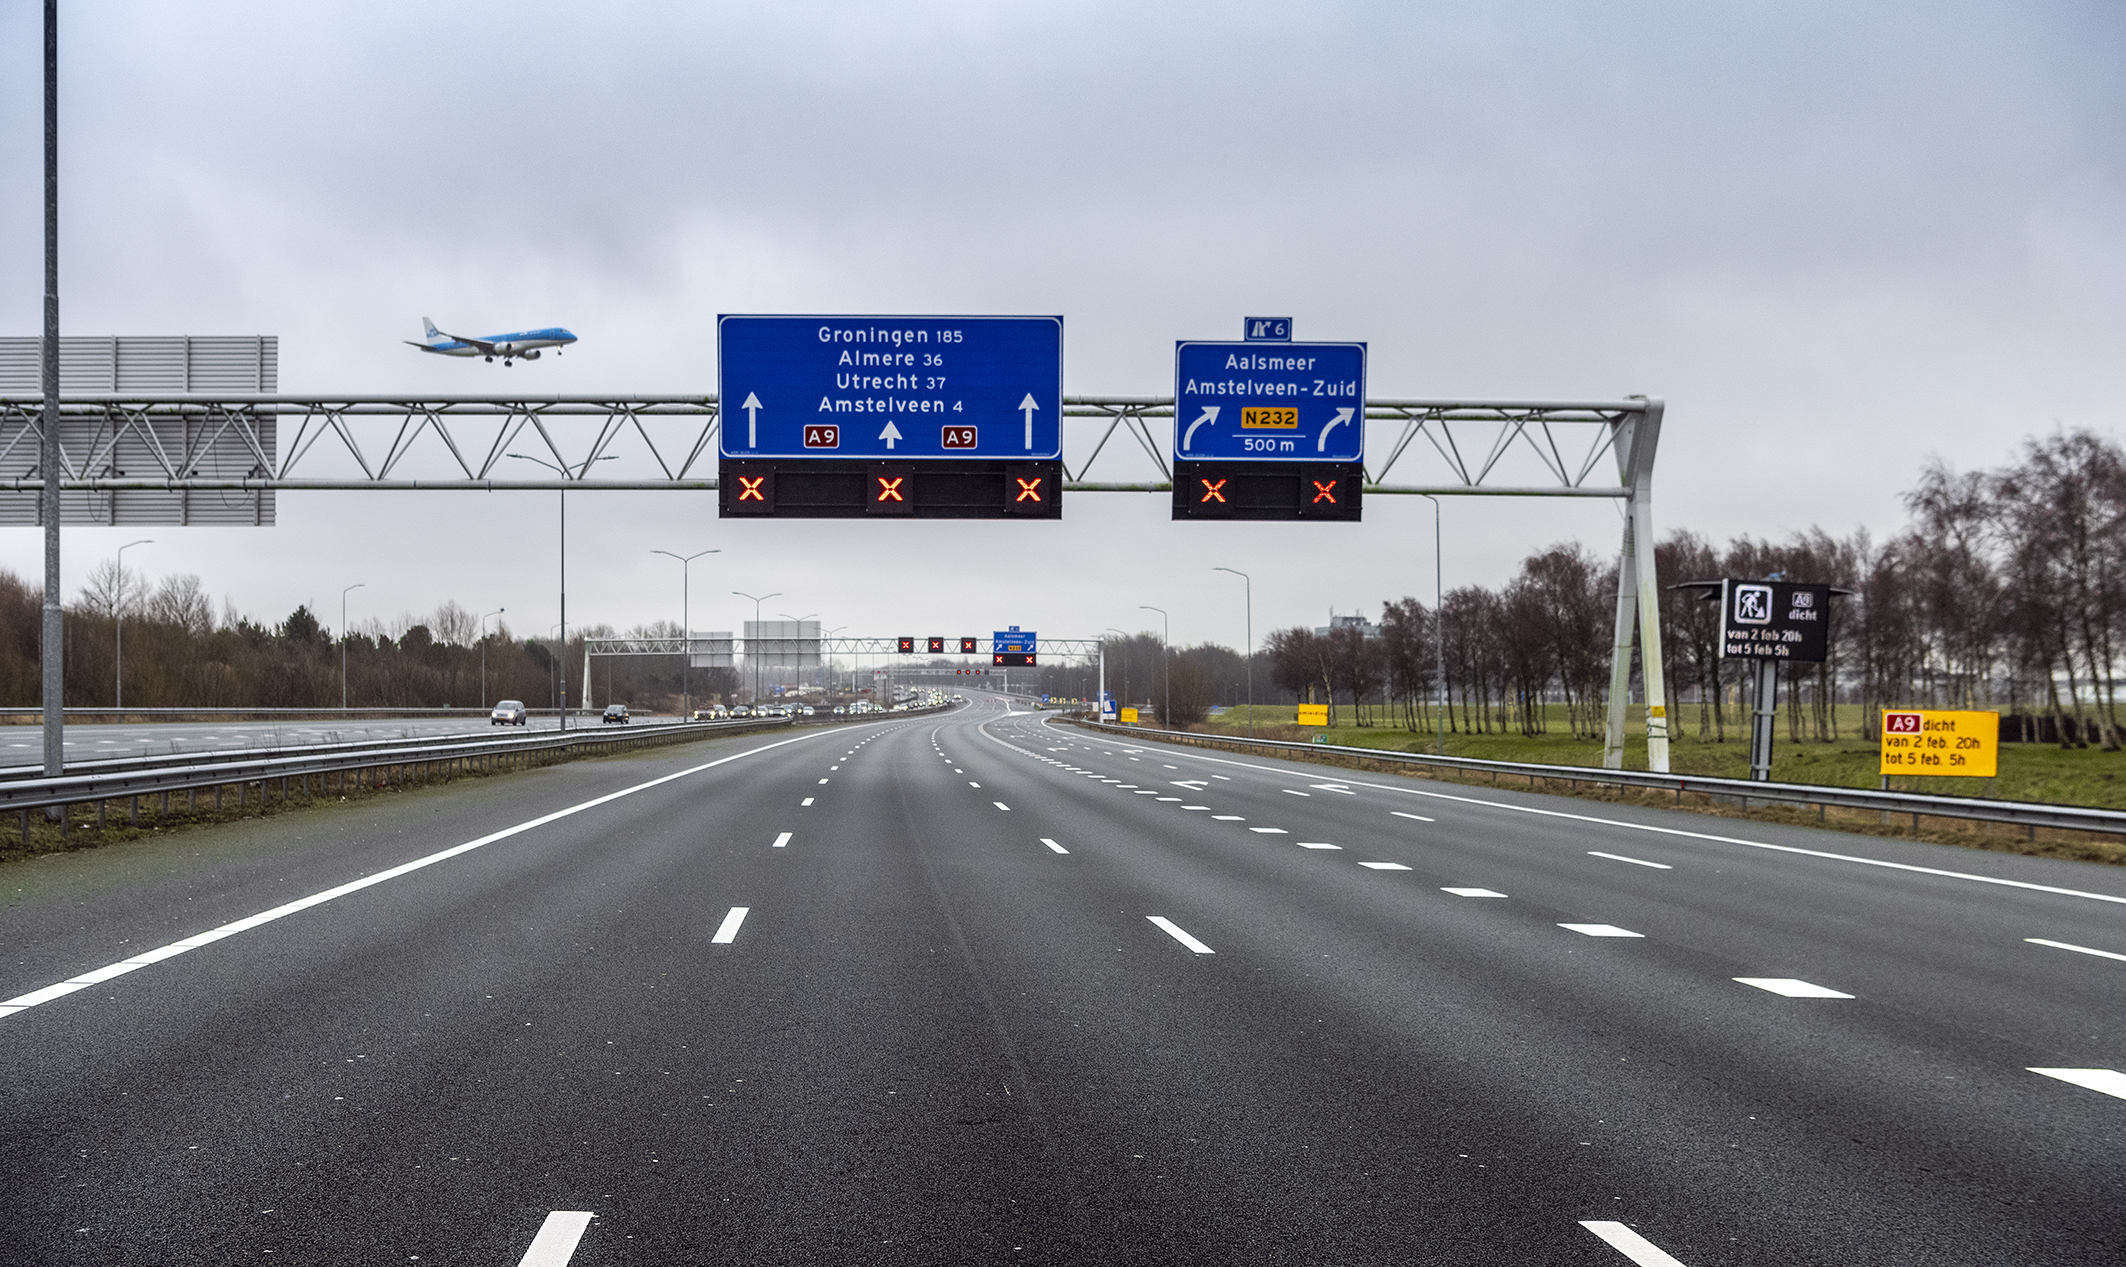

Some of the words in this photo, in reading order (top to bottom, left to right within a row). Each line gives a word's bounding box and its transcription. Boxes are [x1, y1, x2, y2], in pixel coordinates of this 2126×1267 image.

[1275, 323, 1285, 336] 6
[818, 327, 928, 347] Groningen
[936, 330, 963, 344] 185
[839, 350, 914, 367] Almere
[923, 354, 943, 367] 36
[1225, 354, 1316, 370] Aalsmeer
[837, 374, 918, 390] Utrecht
[926, 377, 946, 390] 37
[1185, 379, 1356, 396] Amstelveen-Zuid
[819, 397, 944, 413] Amstelveen
[953, 400, 963, 413] 4
[1246, 411, 1295, 425] N232
[808, 430, 835, 444] A9
[947, 431, 973, 445] A9
[1244, 439, 1275, 451] 500
[1280, 441, 1294, 451] m
[1789, 610, 1817, 621] dicht
[1727, 631, 1749, 639] van
[1751, 630, 1758, 640] 2
[1761, 630, 1779, 641] feb
[1782, 631, 1803, 642] 20h
[1727, 644, 1742, 654] tot
[1744, 643, 1751, 655] 5
[1754, 644, 1772, 655] feb
[1775, 645, 1790, 656] 5h
[1893, 717, 1916, 731] A9
[1923, 720, 1955, 732] dicht
[1886, 737, 1909, 747] van
[1914, 736, 1922, 748] 2
[1927, 737, 1949, 749] feb.
[1956, 738, 1981, 749] 20h
[1886, 754, 1902, 764] tot
[1908, 753, 1916, 765] 5
[1921, 754, 1942, 766] feb.
[1950, 754, 1966, 766] 5h
